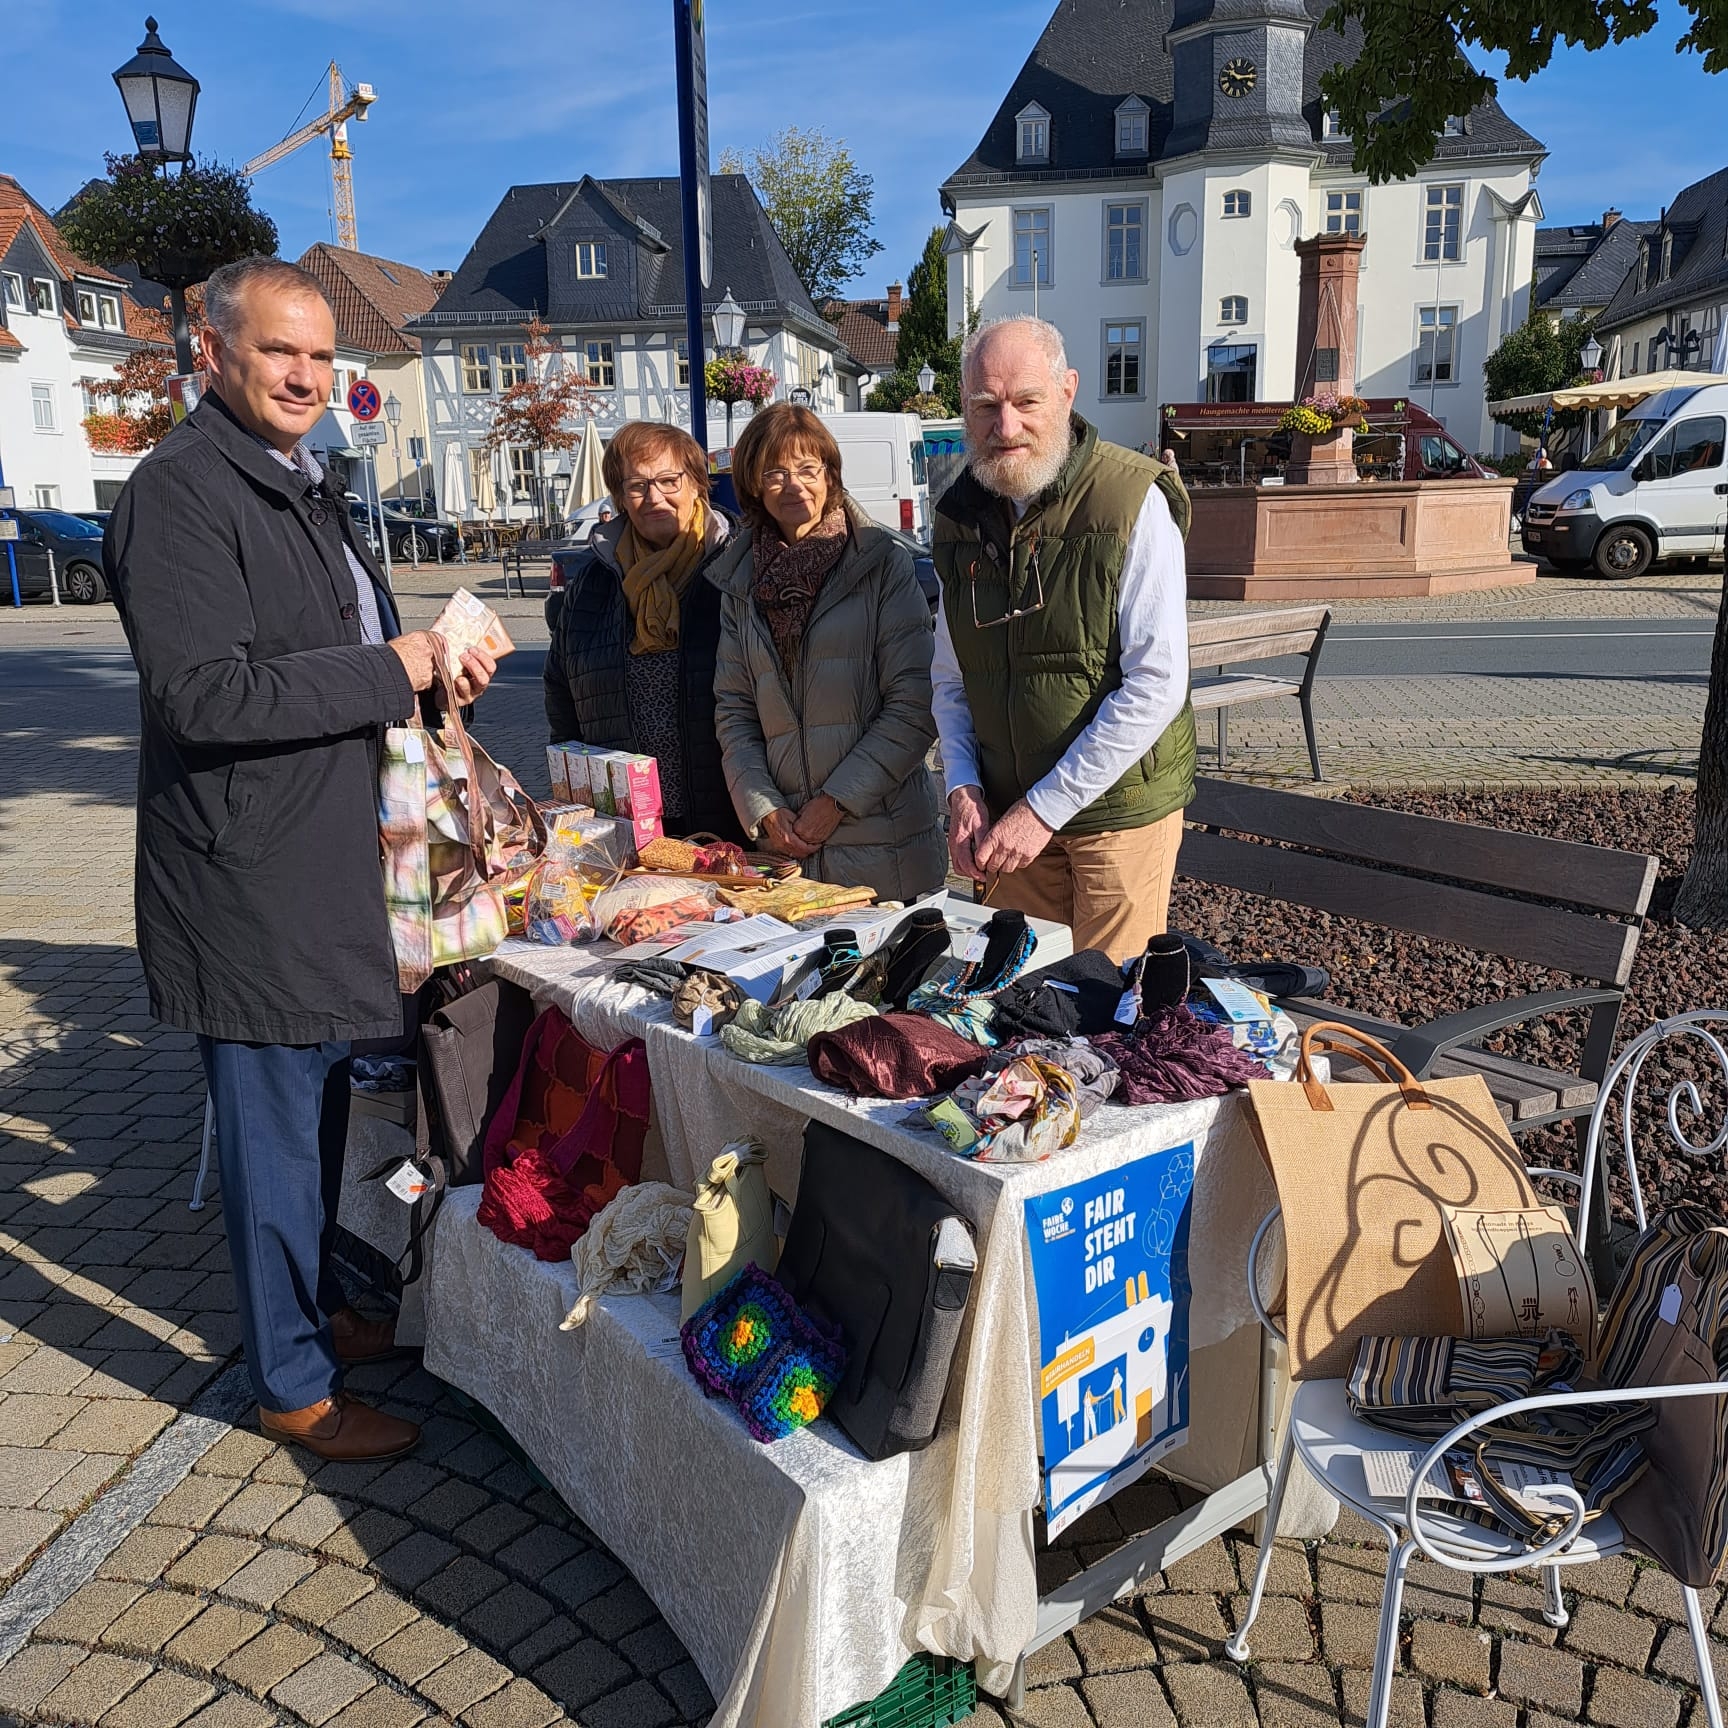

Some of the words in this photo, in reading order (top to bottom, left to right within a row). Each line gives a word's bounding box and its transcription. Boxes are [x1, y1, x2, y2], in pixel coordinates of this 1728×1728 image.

[1199, 406, 1250, 416] Hausgemachte
[1042, 1212, 1065, 1229] FAIRE
[1084, 1187, 1125, 1230] FAIR
[1043, 1221, 1070, 1239] WOCHE
[1084, 1211, 1137, 1262] STEHT
[1084, 1255, 1116, 1295] DIR
